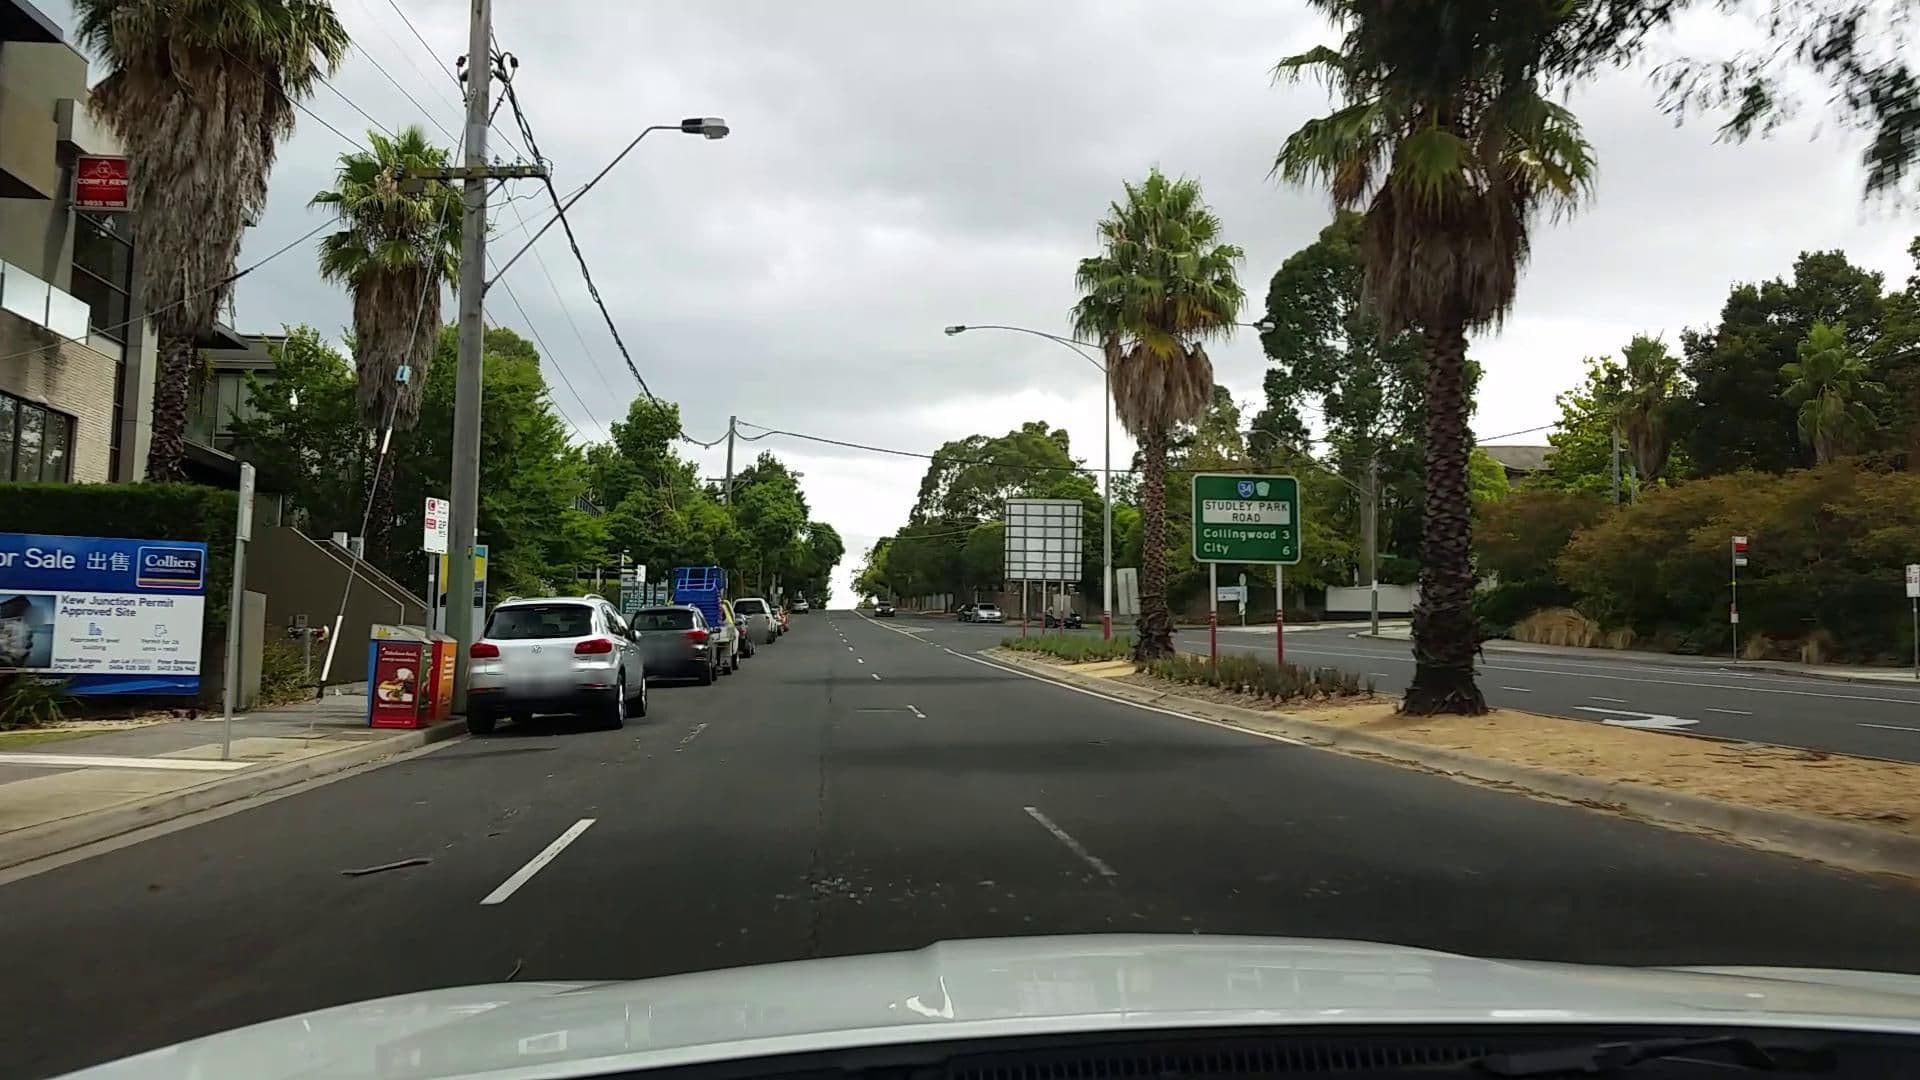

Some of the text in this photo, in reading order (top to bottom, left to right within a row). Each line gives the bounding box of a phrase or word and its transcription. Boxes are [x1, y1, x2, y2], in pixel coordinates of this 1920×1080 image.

[1240, 484, 1252, 493] 34
[1205, 501, 1288, 512] STUDLEY PARK
[1232, 513, 1261, 522] ROAD
[1203, 528, 1290, 541] Collingwood 3
[1203, 543, 1291, 555] City 6
[24, 547, 76, 570] Sale
[86, 551, 131, 572] 出售
[145, 554, 197, 569] Colliers
[60, 595, 174, 608] Kew Junction Permit
[60, 606, 137, 617] Approved Site
